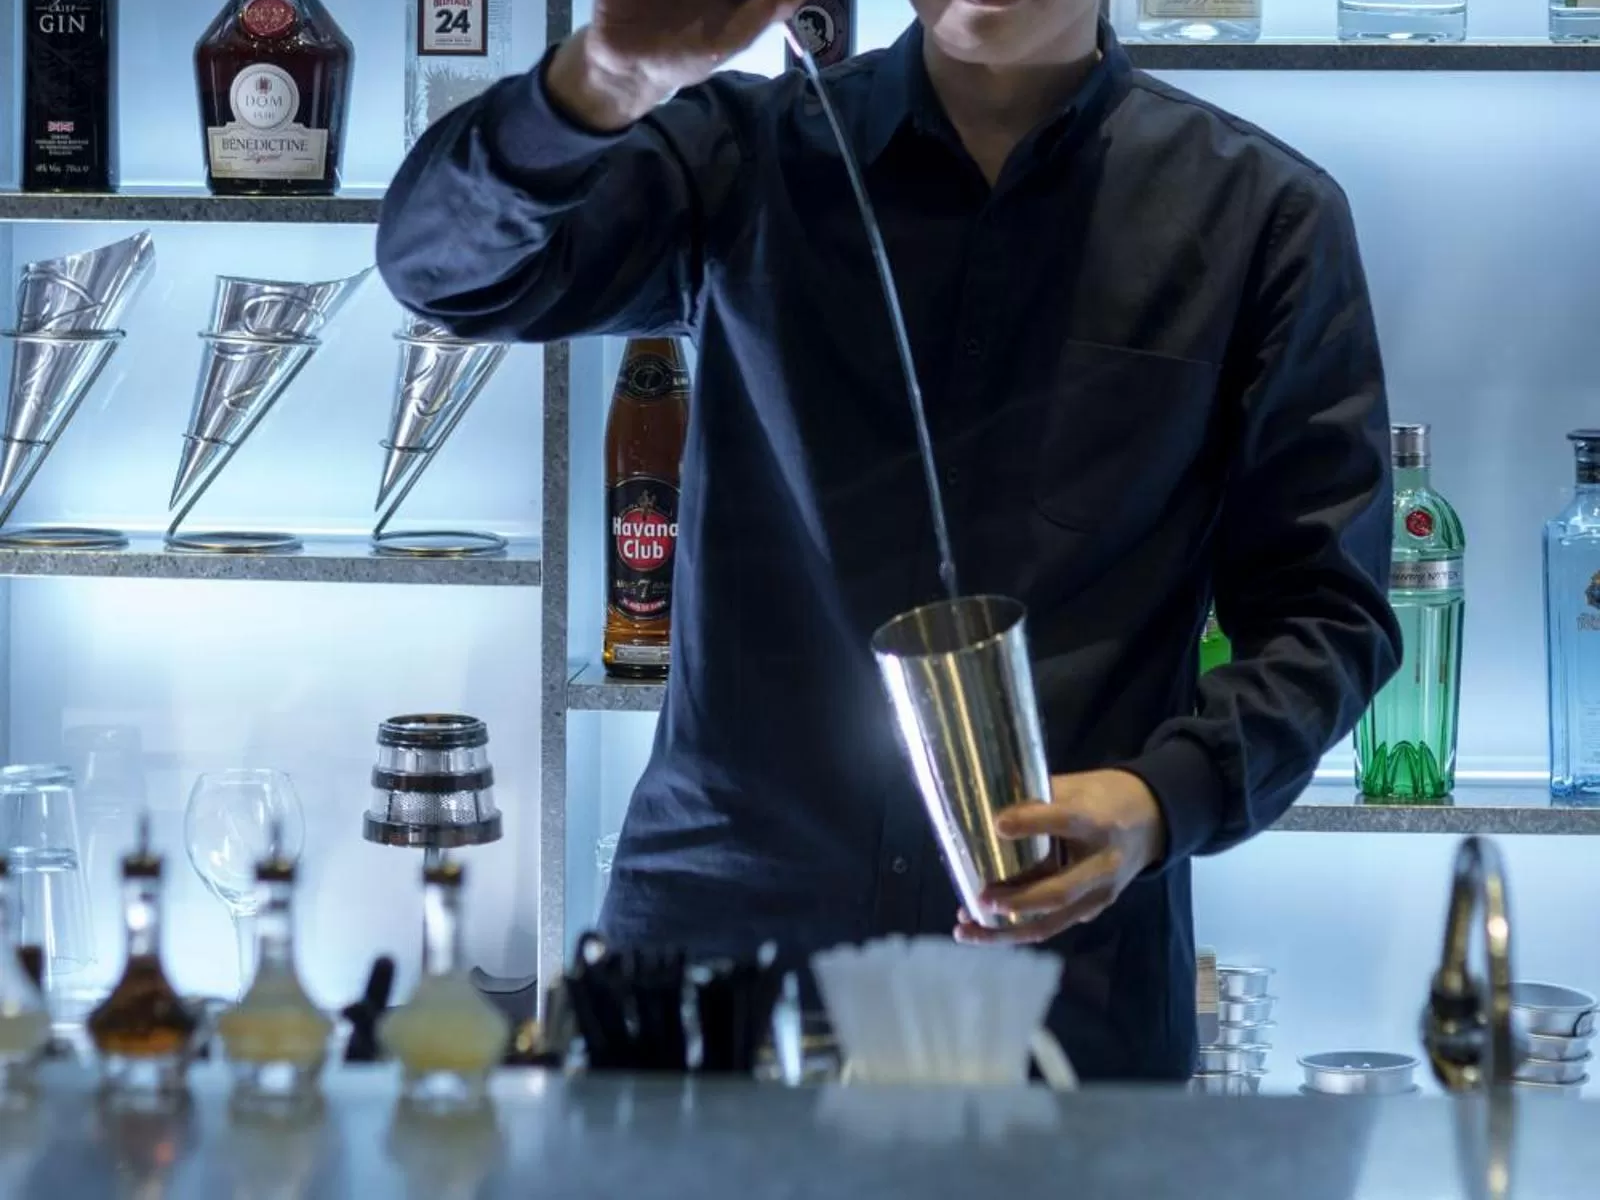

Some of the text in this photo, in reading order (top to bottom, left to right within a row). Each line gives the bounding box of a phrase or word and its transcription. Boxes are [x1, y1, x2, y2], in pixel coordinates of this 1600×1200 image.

[39, 14, 86, 33] GIN
[435, 8, 472, 34] 24
[245, 95, 283, 108] DOM
[612, 516, 680, 537] Havana
[623, 539, 664, 559] Club
[638, 579, 651, 598] 7
